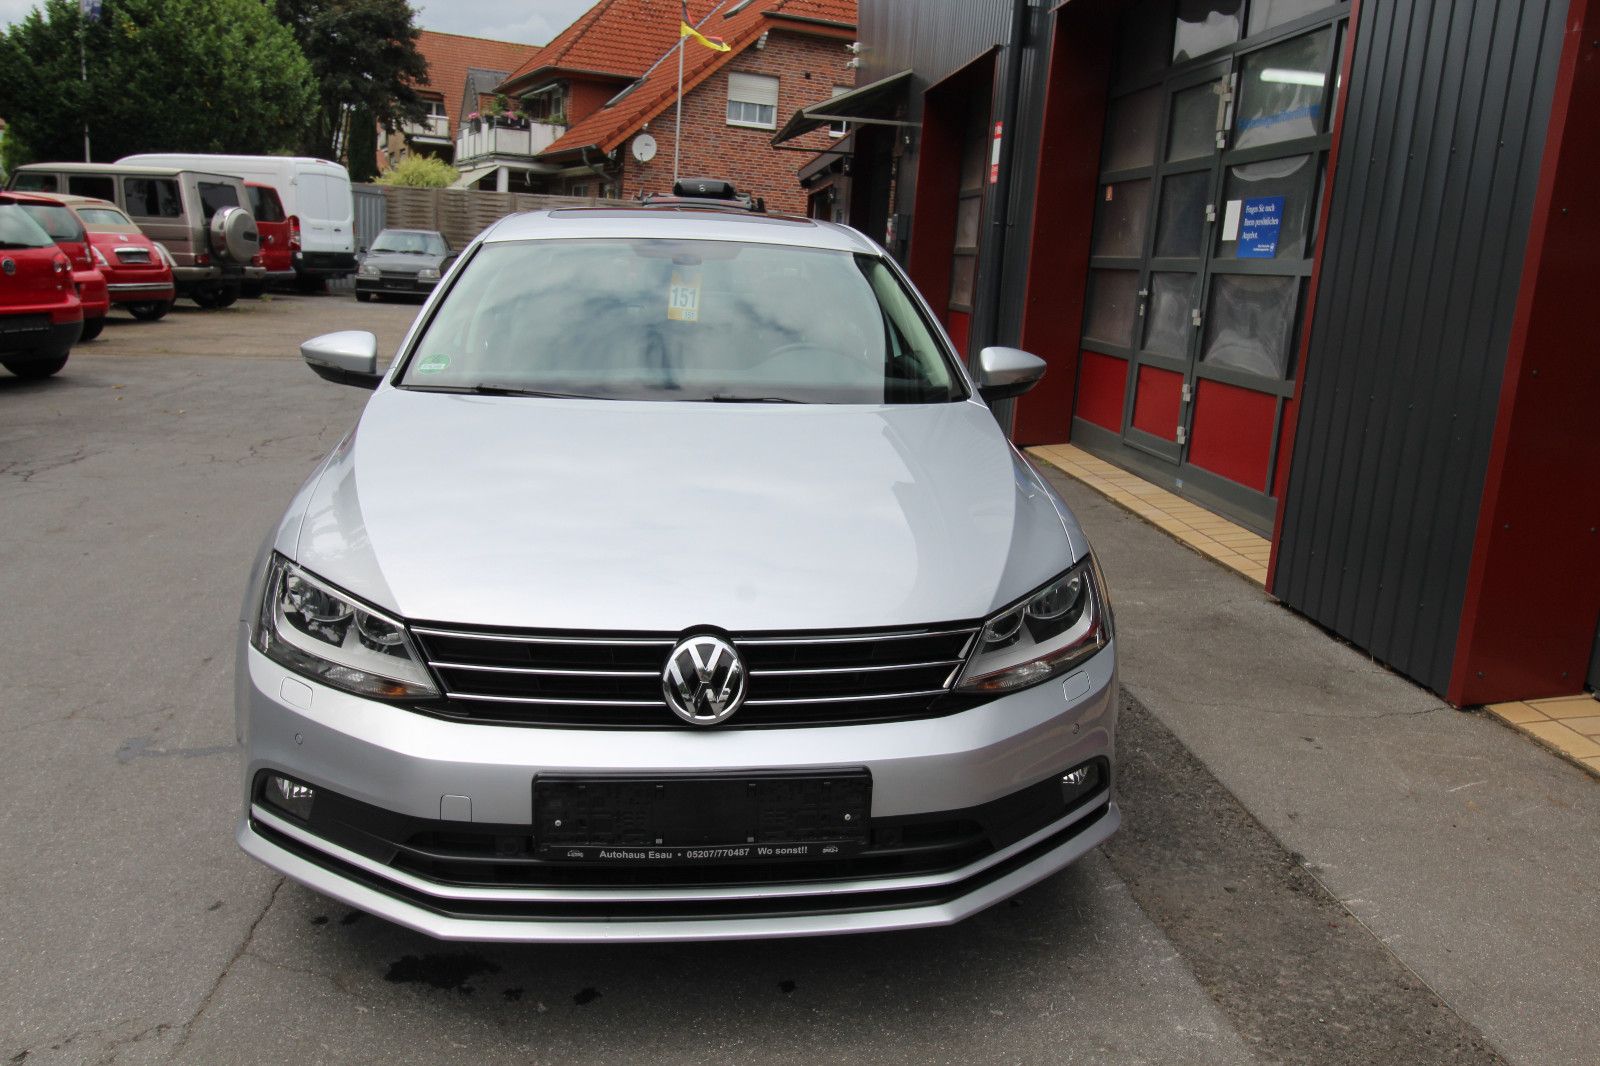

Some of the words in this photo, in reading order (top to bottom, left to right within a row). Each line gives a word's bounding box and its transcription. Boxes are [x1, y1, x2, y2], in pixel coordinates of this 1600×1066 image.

[671, 287, 697, 308] 151
[600, 850, 646, 859] Autohaus
[648, 851, 672, 859] Esau
[686, 848, 750, 858] 05207/770487
[757, 847, 773, 855] Wo
[775, 846, 808, 855] sonst!!
